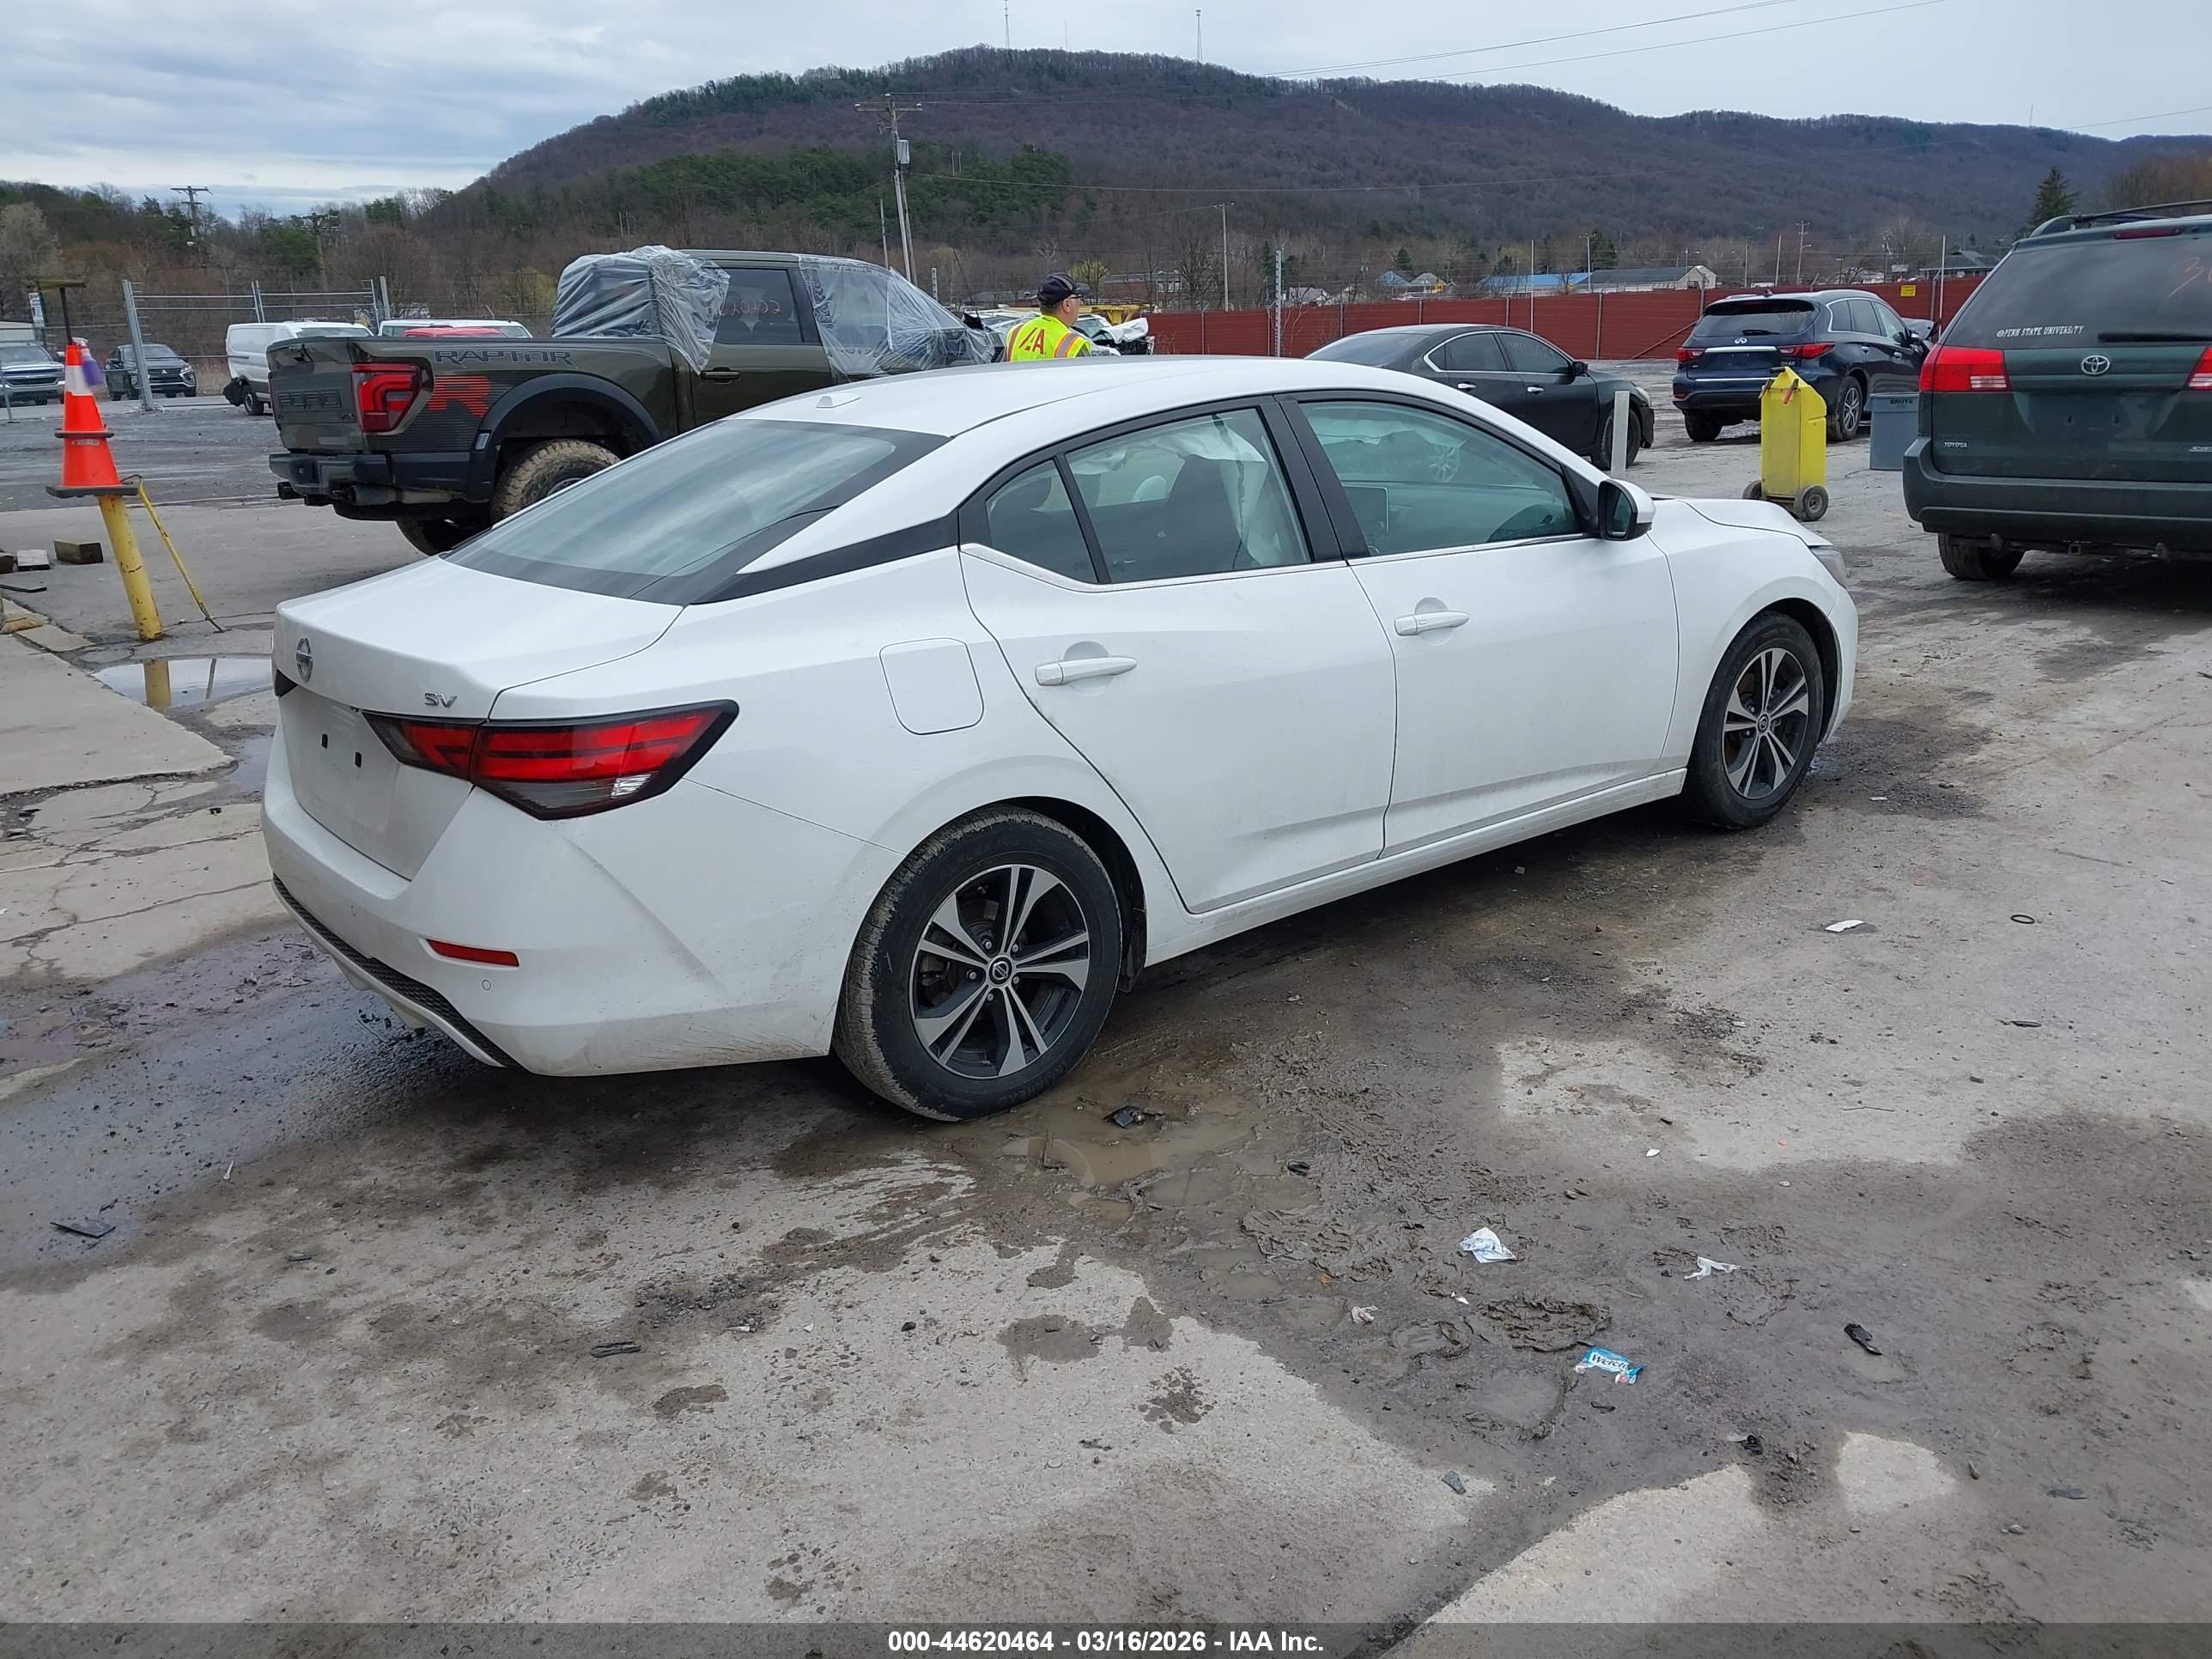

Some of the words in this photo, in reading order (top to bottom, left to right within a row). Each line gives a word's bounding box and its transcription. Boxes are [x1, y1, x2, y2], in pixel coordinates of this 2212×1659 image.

[2021, 326, 2043, 336] STATE
[2044, 325, 2084, 335] UNIVERSITY
[434, 349, 579, 369] RAPTOR
[278, 390, 343, 410] FORD
[427, 374, 490, 417] R
[424, 692, 458, 708] SV
